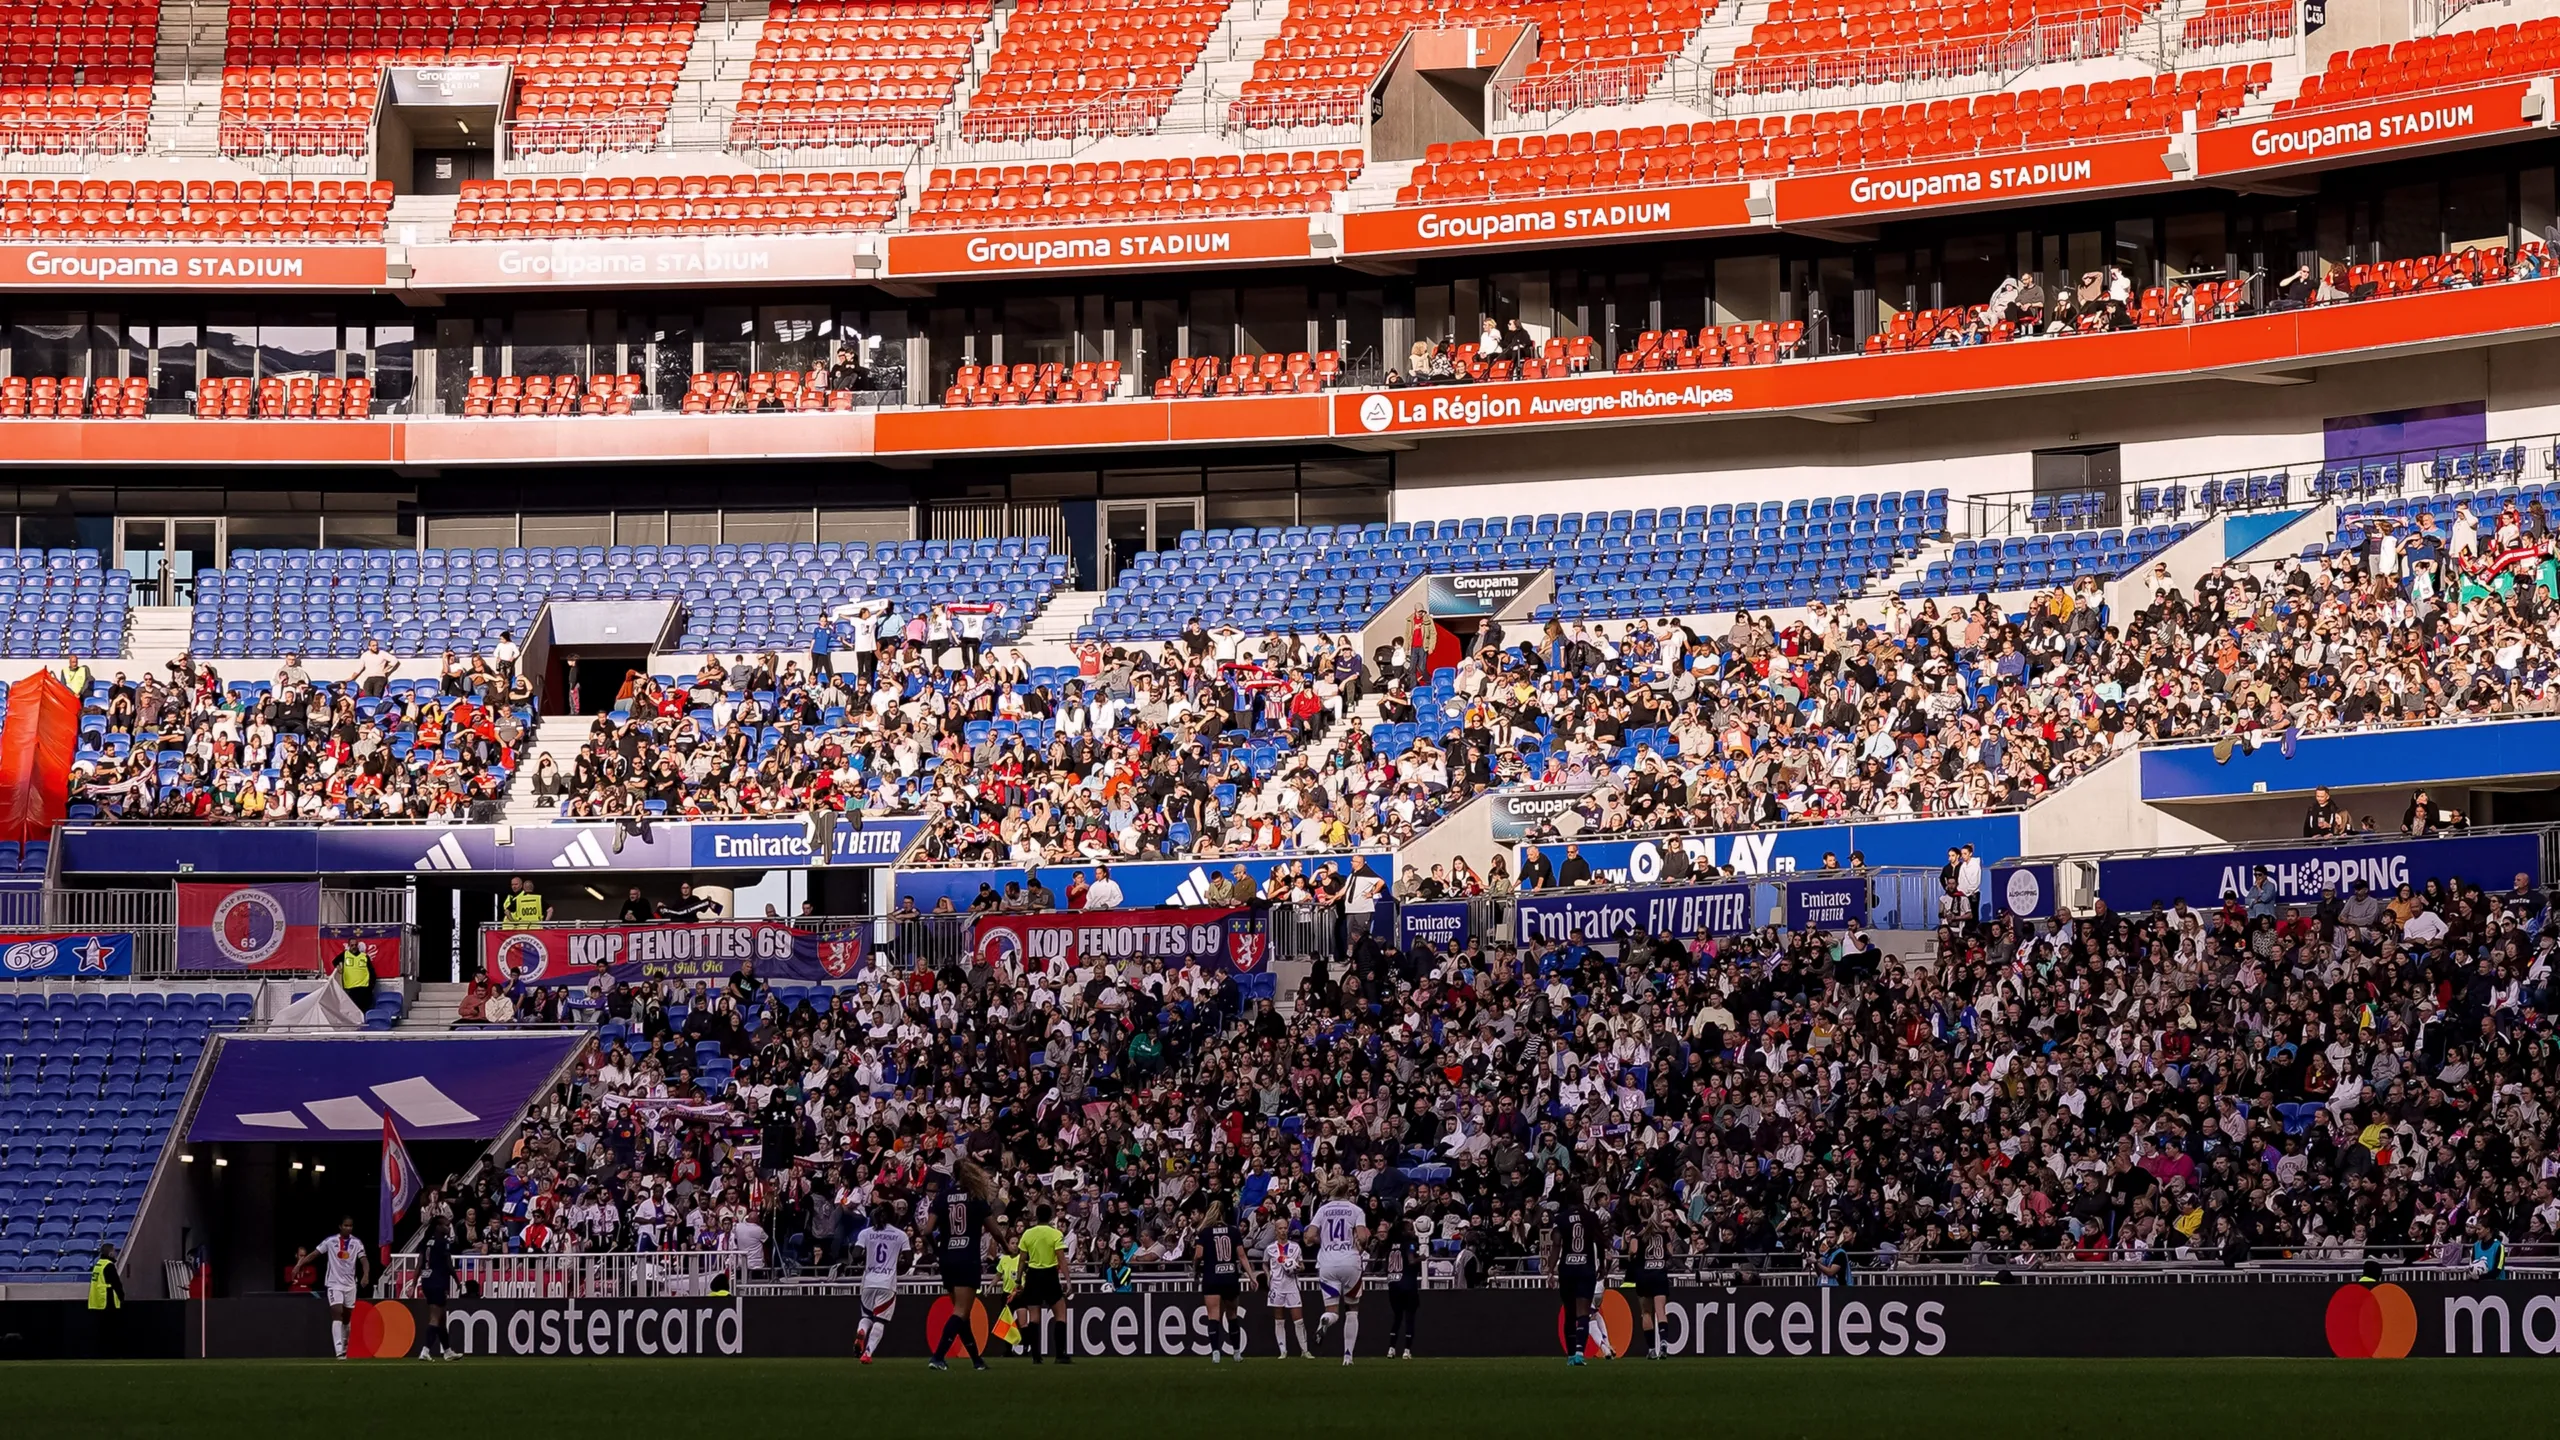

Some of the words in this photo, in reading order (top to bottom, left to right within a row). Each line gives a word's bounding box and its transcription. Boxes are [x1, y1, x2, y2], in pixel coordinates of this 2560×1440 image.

[416, 70, 480, 82] Groupama
[2251, 120, 2373, 156] Groupama
[2379, 105, 2474, 138] STADIUM
[1850, 171, 1981, 203] Groupama
[1989, 160, 2091, 189] STADIUM
[1417, 210, 1556, 240] Groupama
[1564, 202, 1671, 228] STADIUM
[966, 237, 1111, 265] Groupama
[1120, 232, 1230, 256] STADIUM
[26, 251, 179, 280] Groupama
[187, 258, 303, 276] STADIUM
[499, 250, 646, 277] Groupama
[656, 251, 769, 272] STADIUM
[1398, 400, 1427, 423] La
[1433, 394, 1521, 424] Région
[1529, 385, 1733, 415] Auvergne-Rhône-Alpes
[1453, 576, 1518, 590] Groupama
[714, 833, 812, 858] Emirates
[848, 831, 902, 854] BETTER
[1801, 891, 1852, 908] Emirates
[1406, 915, 1461, 931] Emirates
[1521, 903, 1637, 943] Emirates
[1648, 897, 1677, 936] FLY
[1682, 893, 1745, 934] BETTER
[1809, 909, 1820, 922] FLY
[1821, 908, 1844, 922] BETTER
[241, 937, 257, 948] 69
[568, 932, 621, 966] KOP
[627, 927, 754, 962] FENOTTES
[757, 927, 792, 959] 69
[1028, 928, 1073, 958] KOP
[1078, 925, 1186, 956] FENOTTES
[1191, 925, 1221, 954] 69
[4, 942, 58, 971] 69
[948, 1203, 967, 1236] 19
[1327, 1218, 1345, 1242] 14
[1213, 1235, 1232, 1262] 10
[1325, 1243, 1352, 1252] VICAT
[1572, 1222, 1584, 1252] 8
[876, 1242, 889, 1264] 6
[868, 1266, 893, 1275] VICAT
[441, 1297, 743, 1355] mastercard
[1655, 1287, 1947, 1357] priceless
